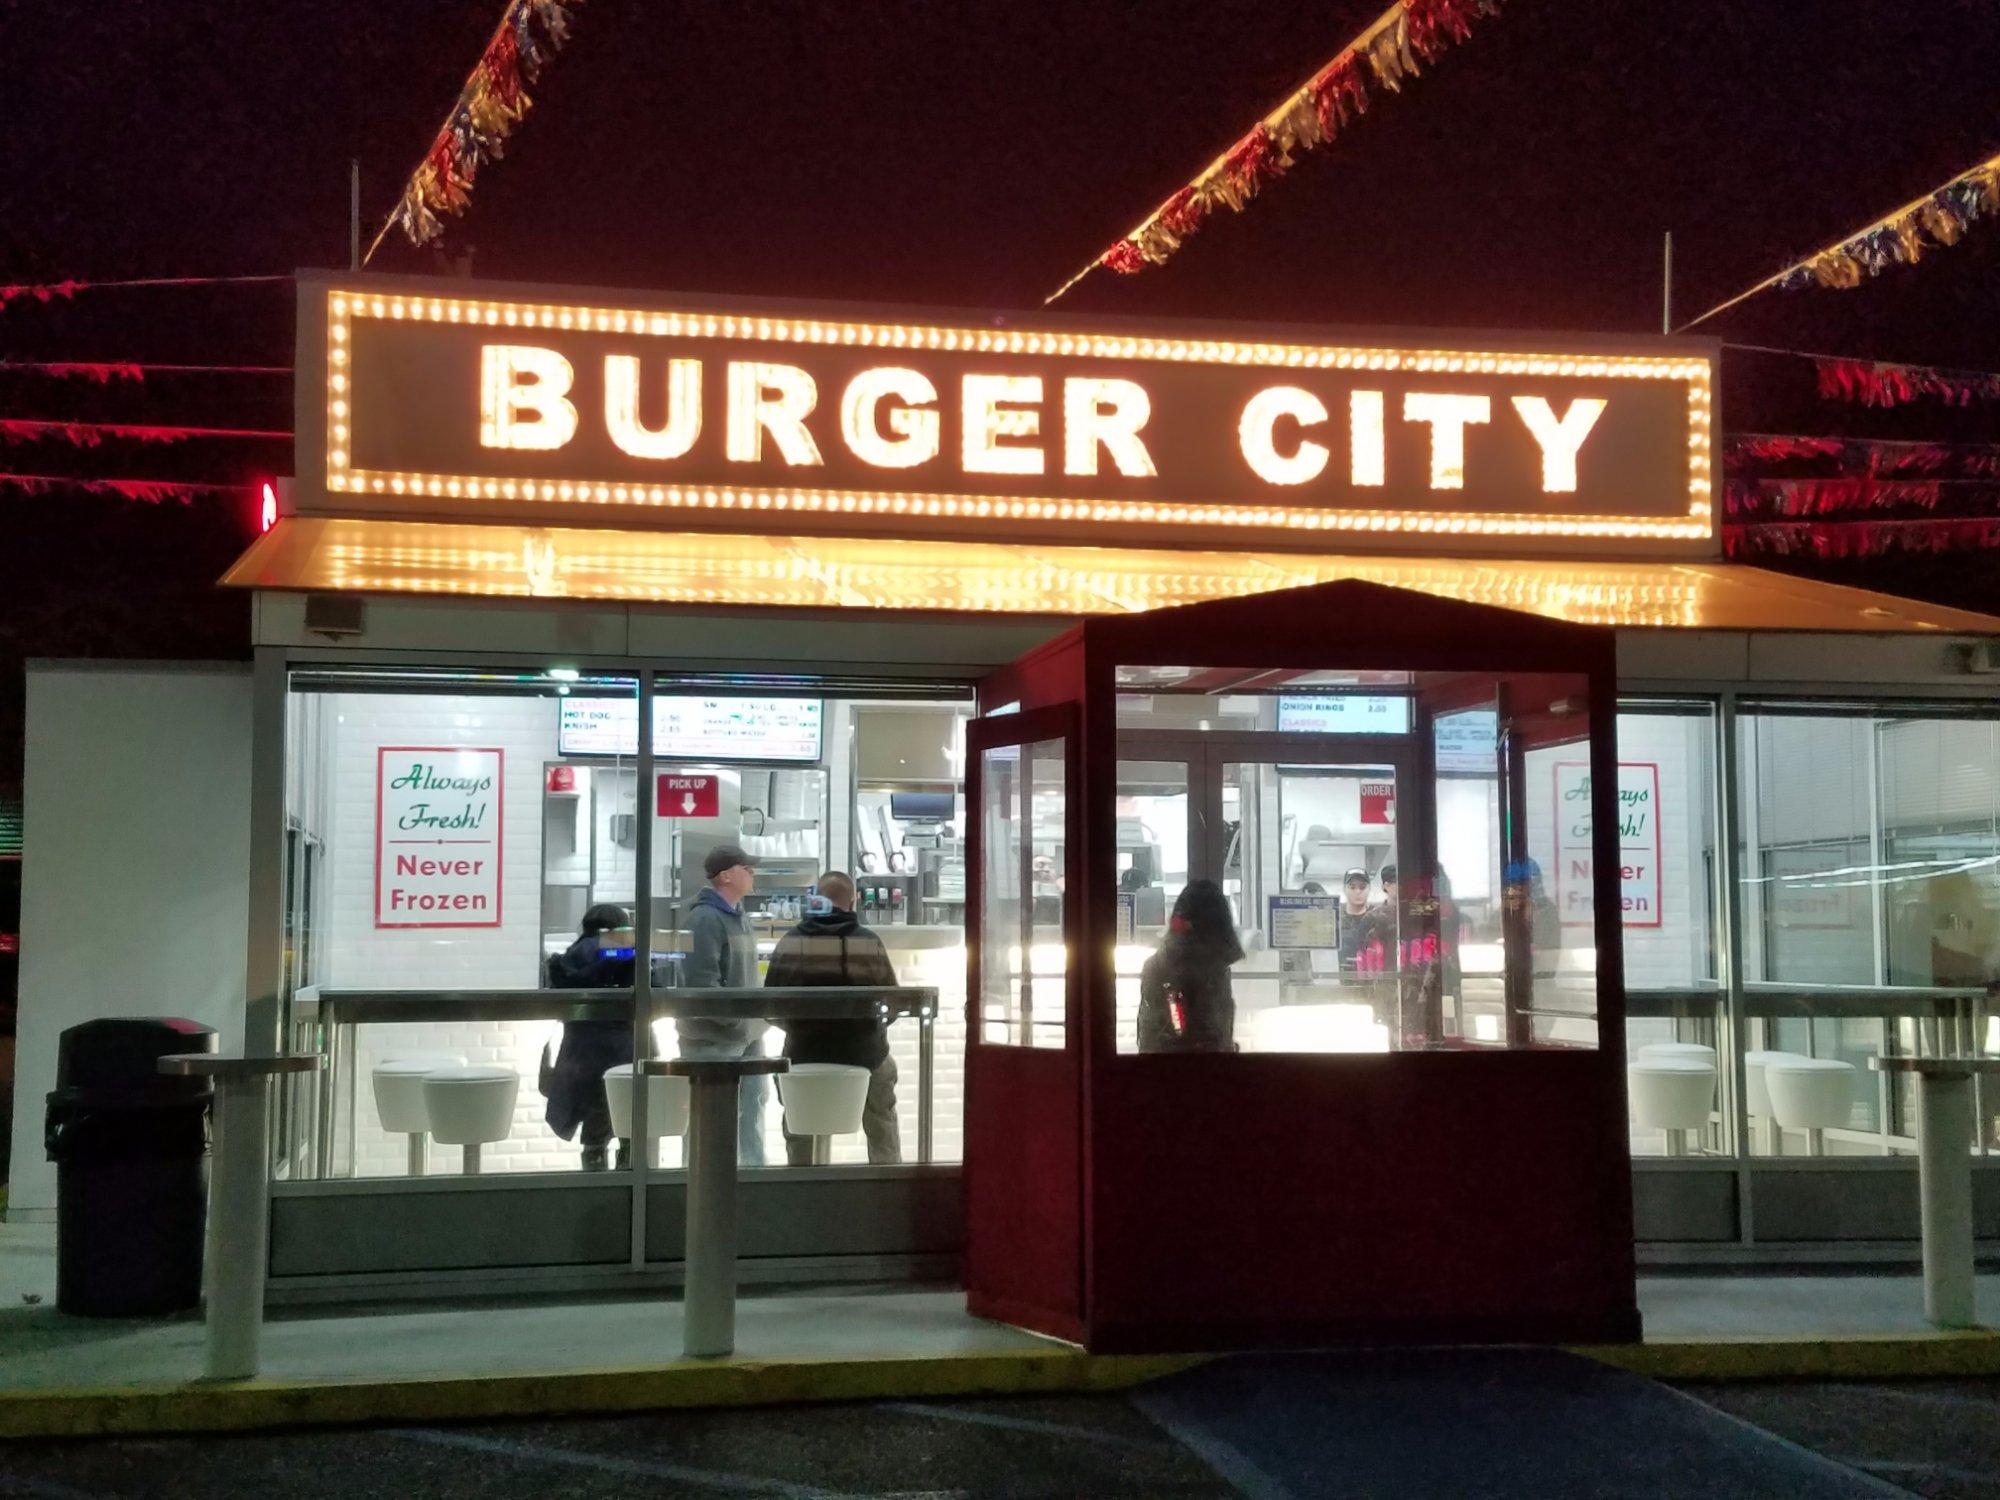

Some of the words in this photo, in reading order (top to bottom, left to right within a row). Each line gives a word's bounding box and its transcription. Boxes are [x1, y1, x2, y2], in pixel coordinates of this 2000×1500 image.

[479, 343, 1159, 478] BURGER
[1237, 385, 1609, 493] CITY
[390, 763, 492, 797] Always
[668, 778, 693, 790] PICK
[693, 778, 708, 790] UP
[1360, 785, 1392, 797] ORDER
[1564, 776, 1649, 808] Aays
[398, 802, 487, 831] Fresh!
[396, 854, 484, 876] Never
[1570, 859, 1646, 880] Ner
[390, 888, 487, 911] Frozen
[1567, 891, 1649, 912] Fren
